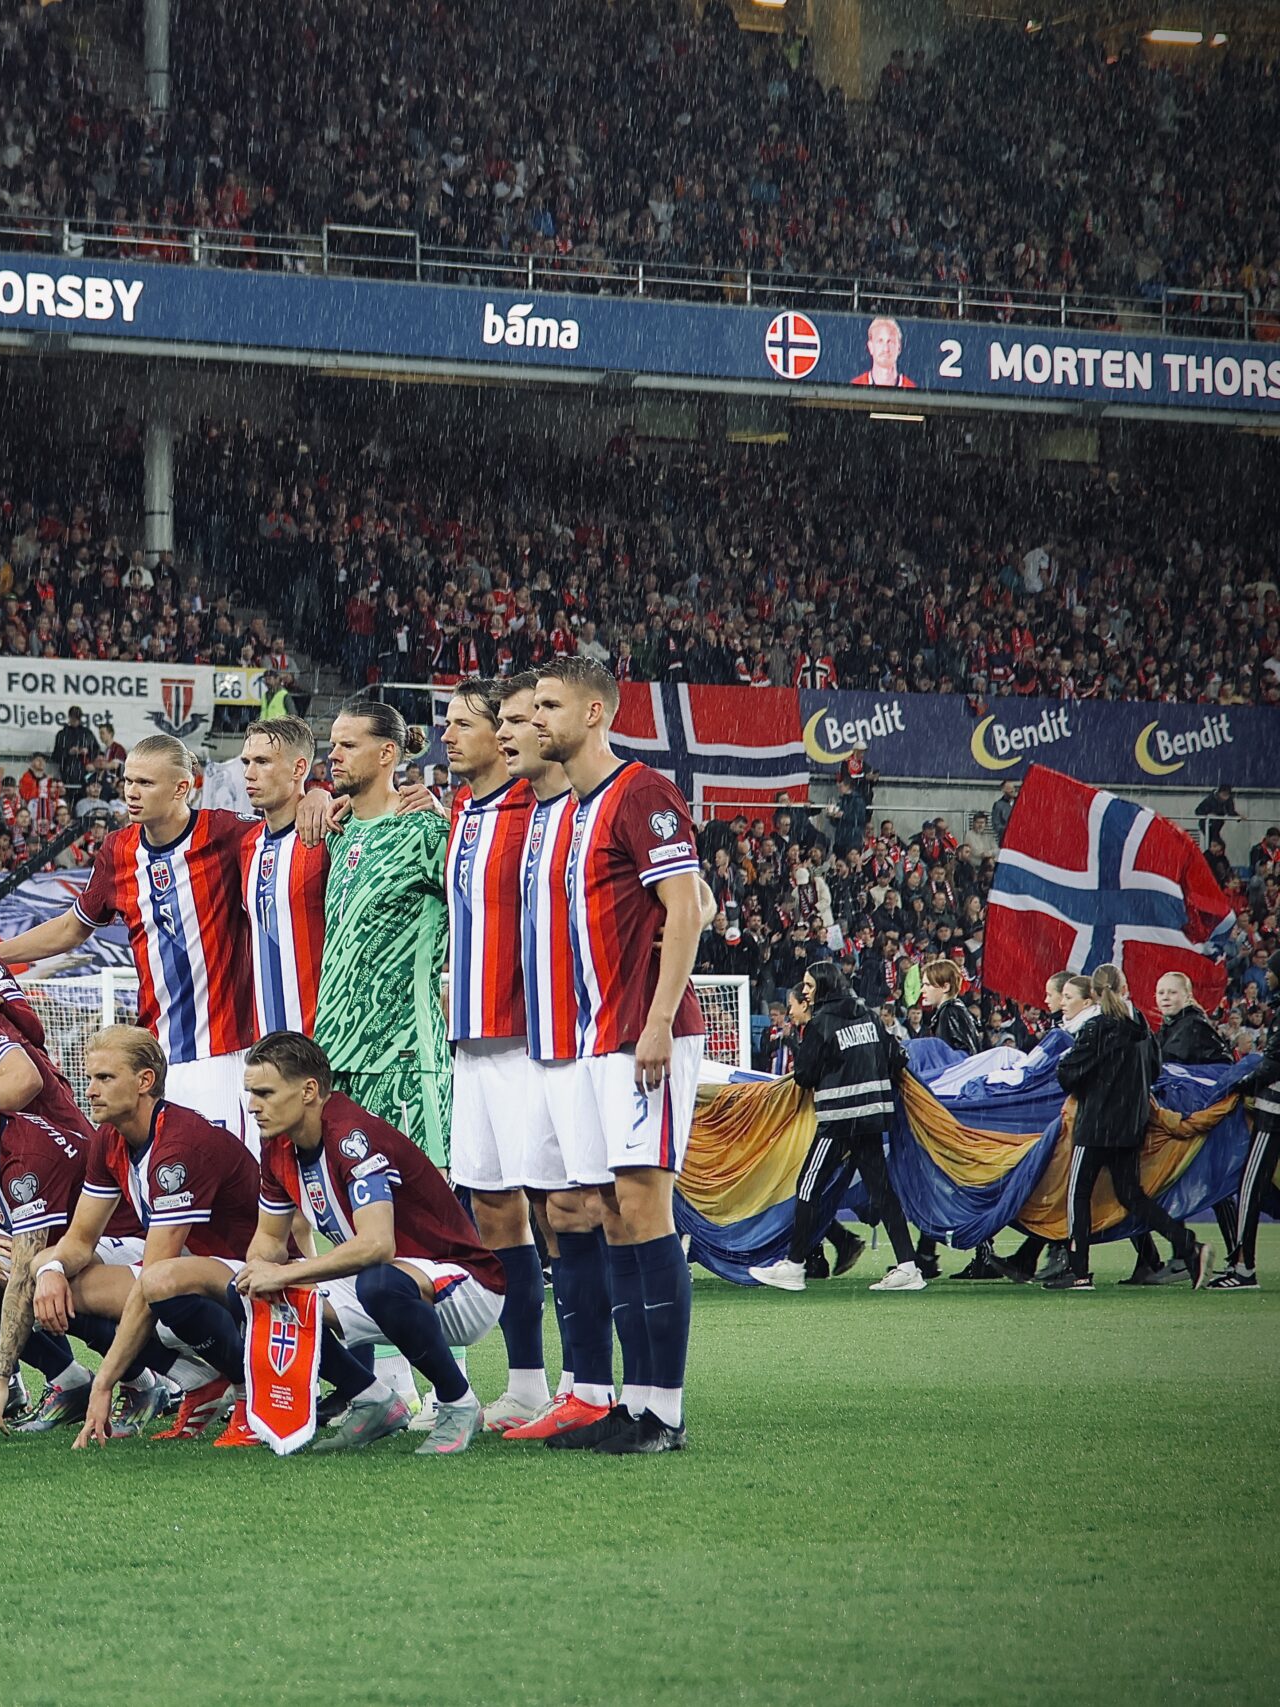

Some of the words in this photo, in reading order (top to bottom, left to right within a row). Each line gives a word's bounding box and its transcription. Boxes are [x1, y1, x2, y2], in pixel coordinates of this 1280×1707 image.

[938, 339, 963, 378] 2
[989, 341, 1152, 390] MORTEN
[7, 672, 55, 694] FOR
[64, 674, 148, 697] NORGE
[824, 700, 906, 750] Bendit
[992, 707, 1072, 756] Bendit
[1156, 714, 1233, 761] Bendit
[353, 1179, 371, 1205] C
